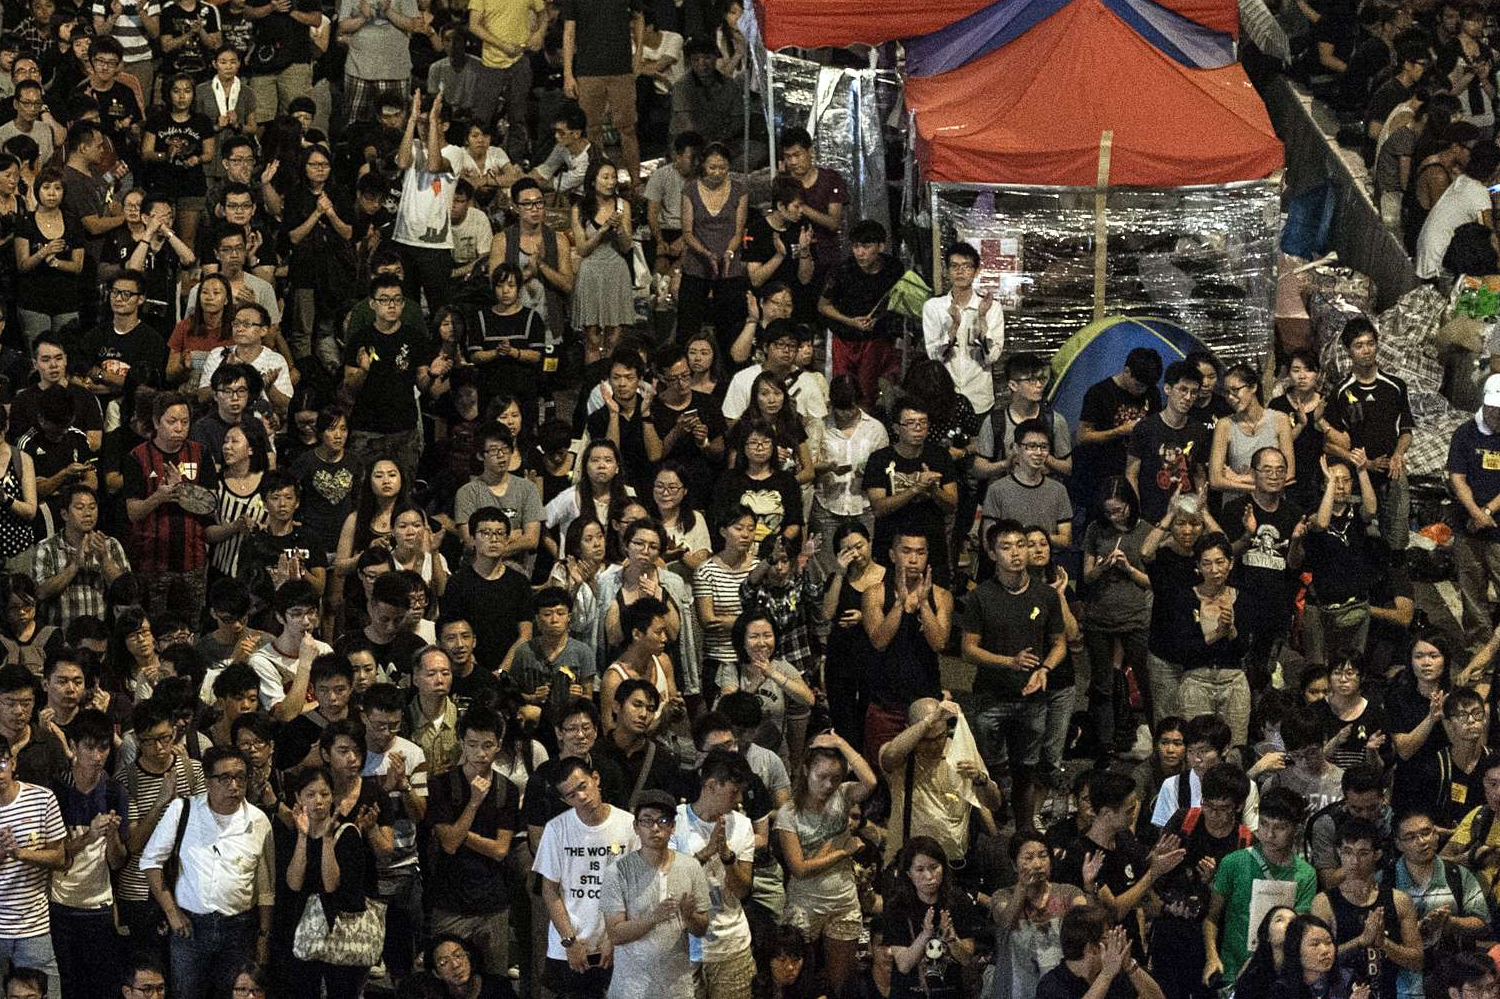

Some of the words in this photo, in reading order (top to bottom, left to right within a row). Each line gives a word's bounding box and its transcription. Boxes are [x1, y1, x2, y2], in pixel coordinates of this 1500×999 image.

[564, 847, 585, 856] THE
[587, 845, 626, 856] WOT
[590, 861, 600, 871] IS
[580, 875, 603, 885] STIL
[570, 888, 584, 899] TO
